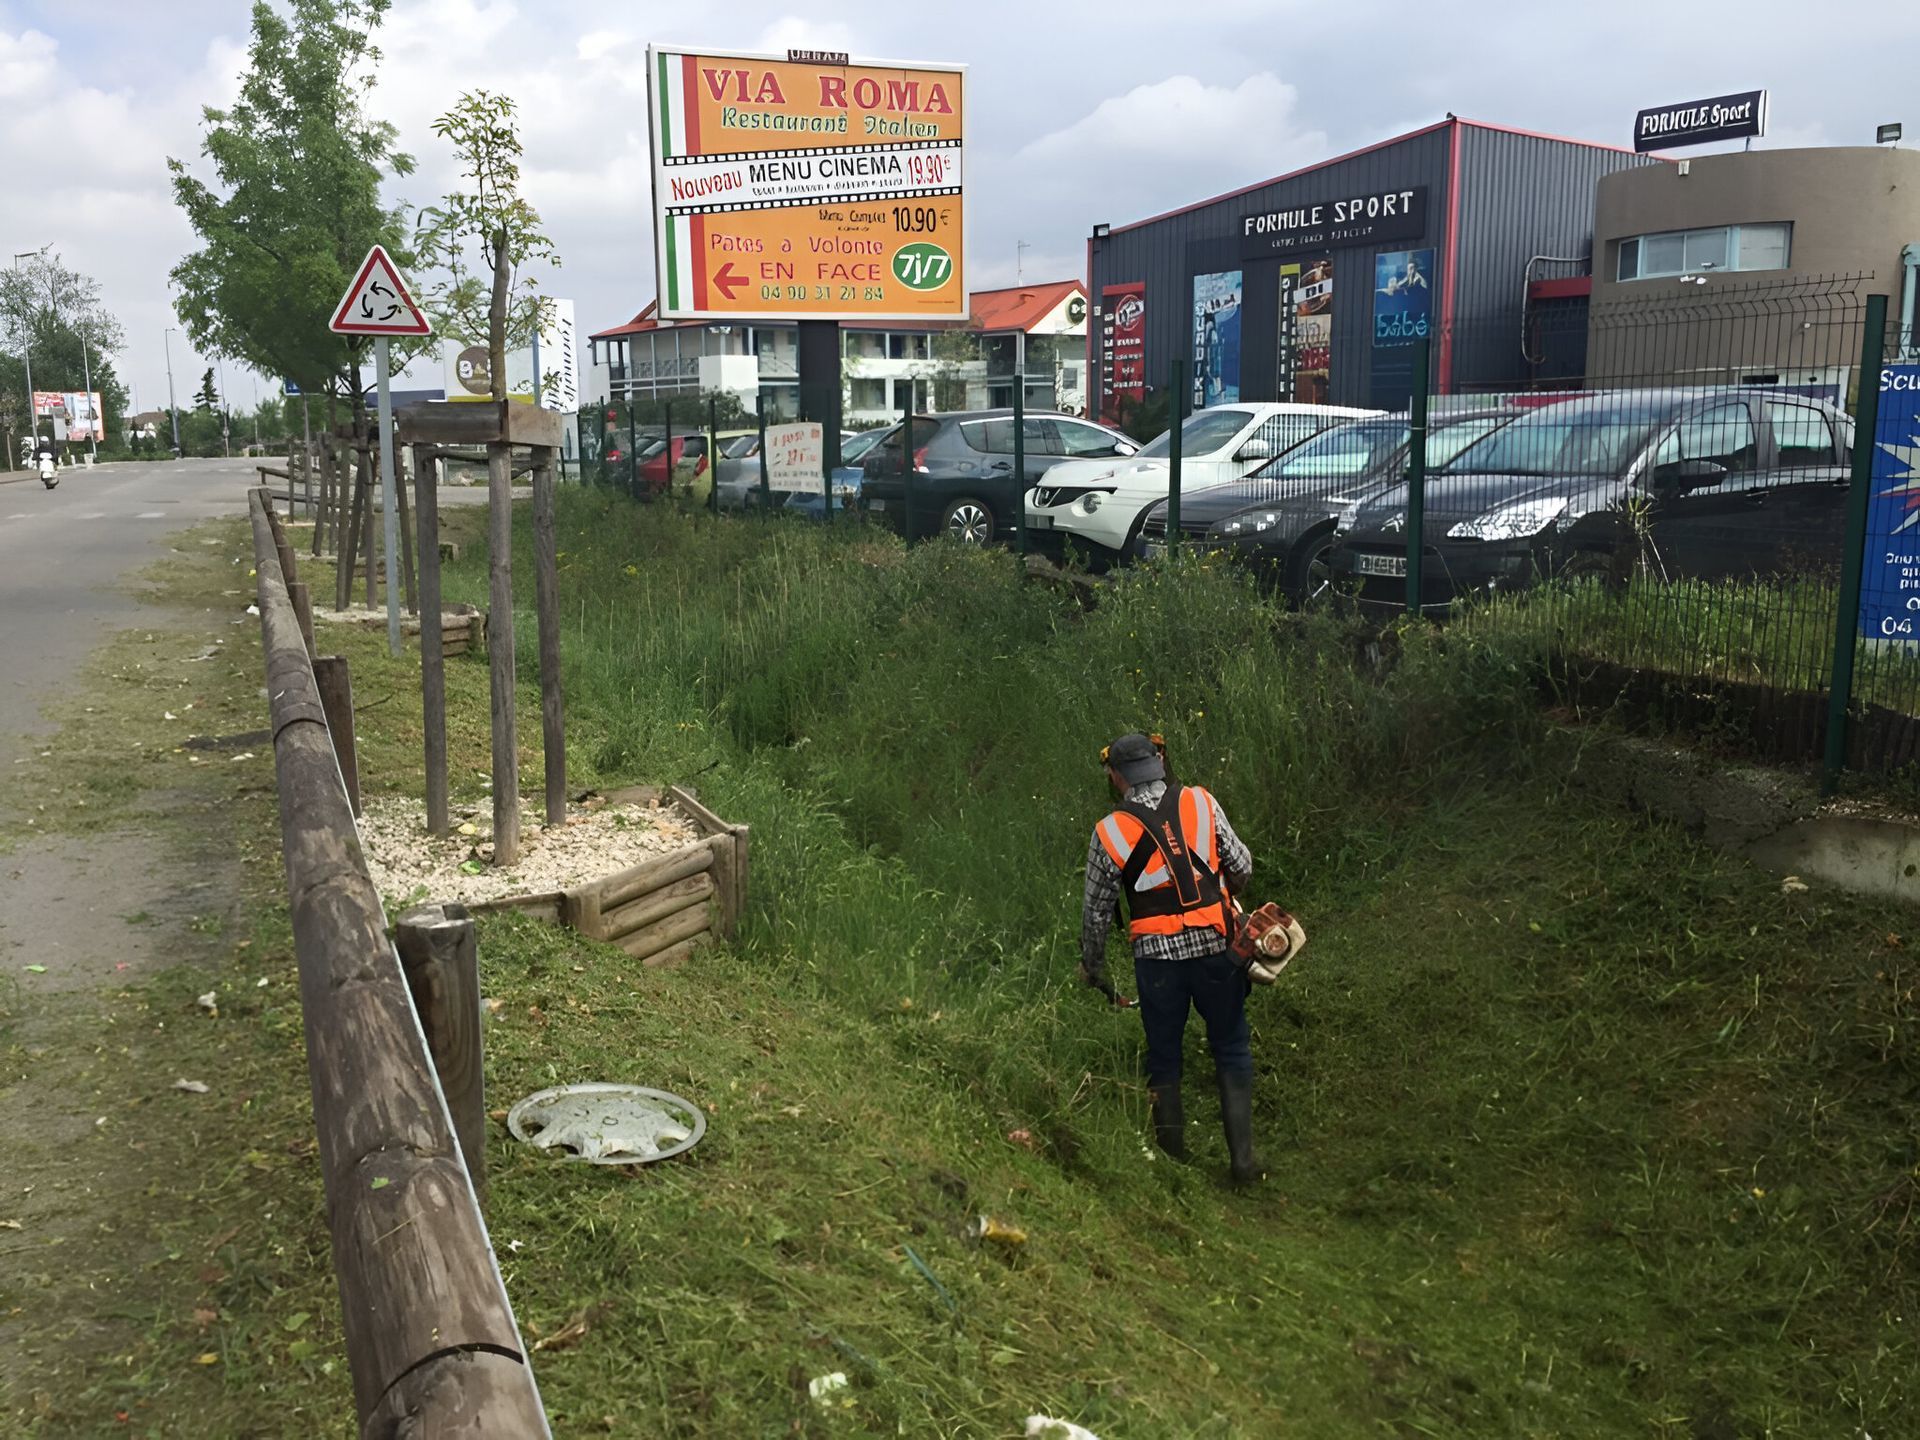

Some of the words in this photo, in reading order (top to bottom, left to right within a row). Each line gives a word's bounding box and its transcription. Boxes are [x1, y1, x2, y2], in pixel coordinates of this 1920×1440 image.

[702, 69, 786, 104] VIA
[819, 76, 952, 114] ROMA
[722, 107, 847, 132] Restaurant
[864, 113, 938, 137] Italien
[1640, 106, 1709, 135] FORMULE
[1711, 101, 1751, 127] Sport
[750, 161, 811, 183] MENU
[819, 155, 902, 178] CINEMA
[671, 170, 742, 201] Nouveau
[1245, 206, 1323, 236] FORMULE
[1334, 191, 1413, 223] SPORT
[760, 262, 793, 280] EN
[817, 263, 880, 281] FACE
